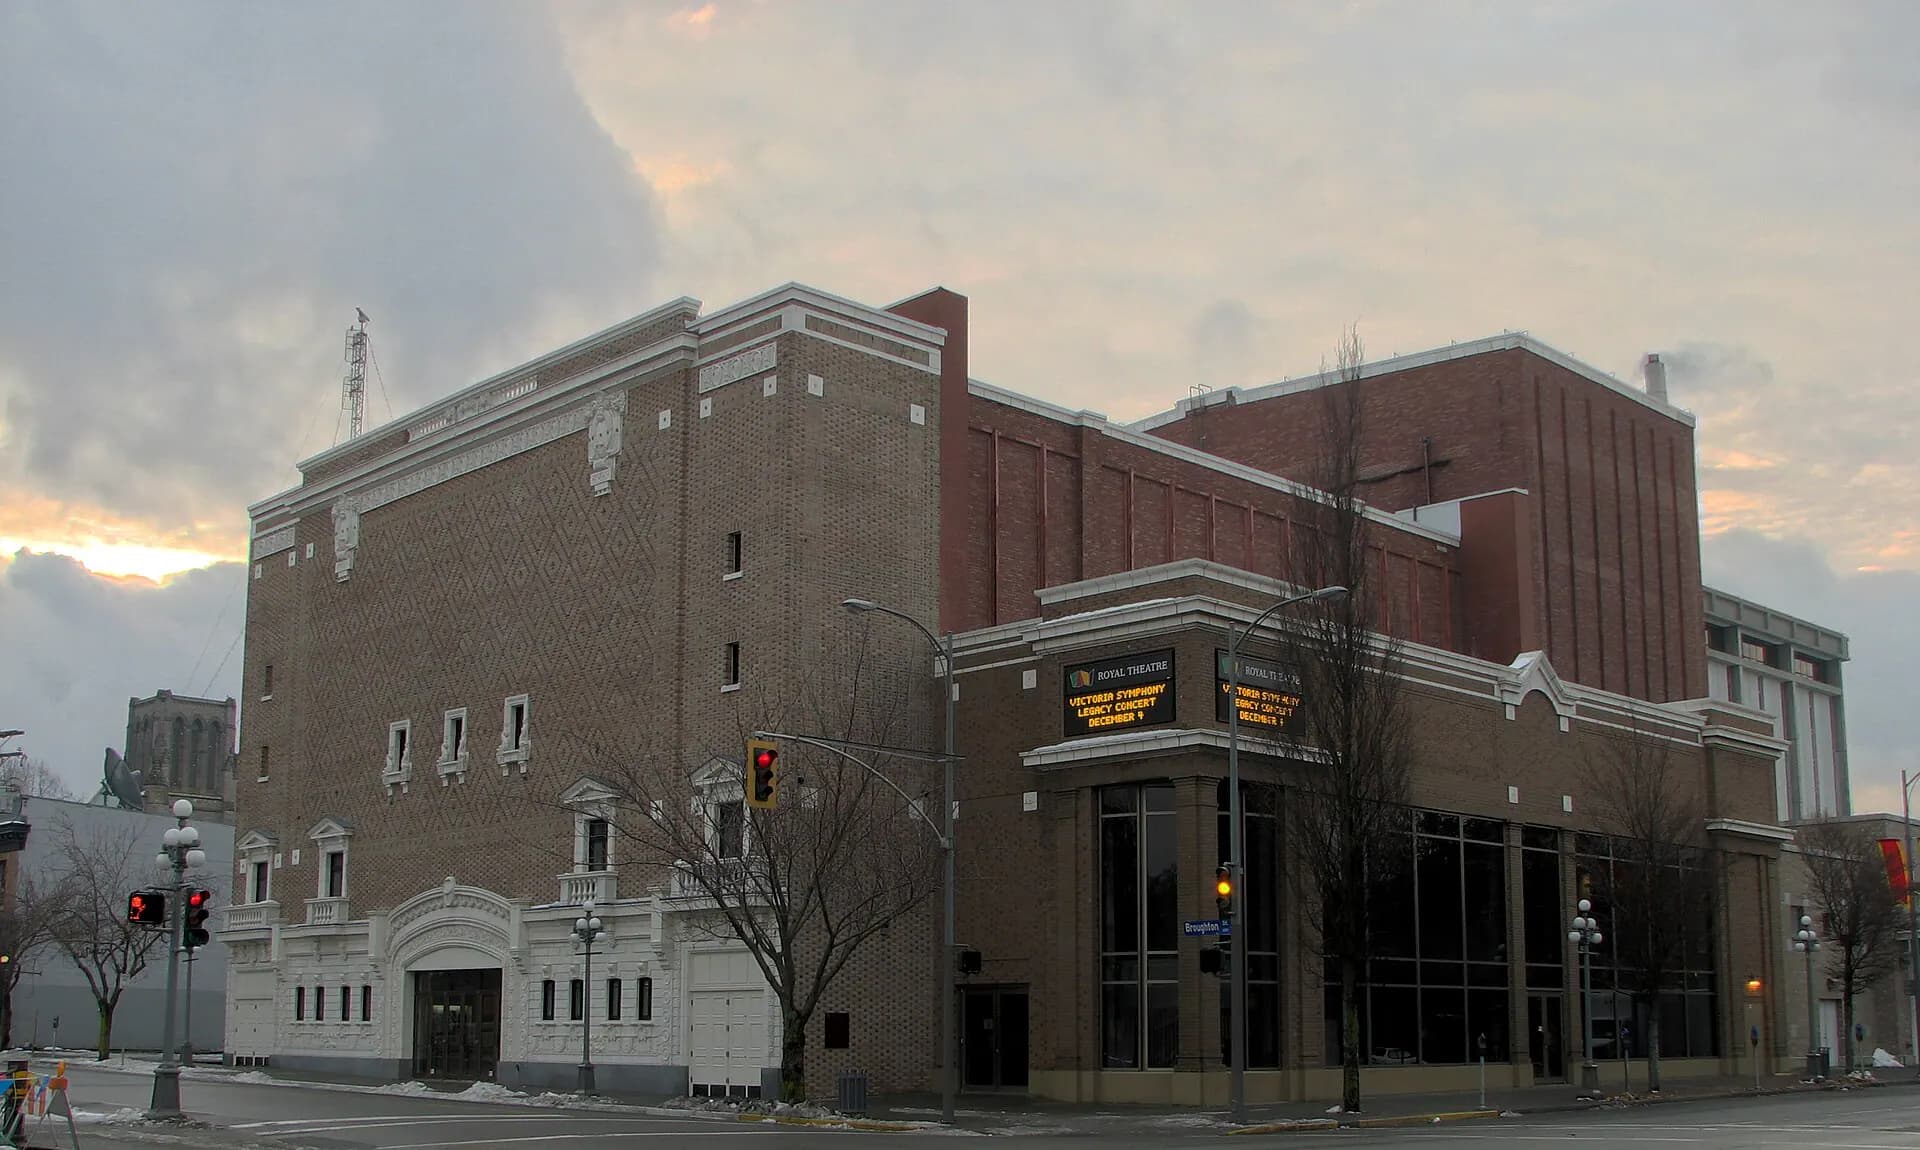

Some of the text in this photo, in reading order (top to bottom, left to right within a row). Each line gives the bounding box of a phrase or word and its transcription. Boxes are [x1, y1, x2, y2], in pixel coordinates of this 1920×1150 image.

[1098, 661, 1168, 680] ROYAL THEATRE
[1245, 666, 1269, 679] ROYAL
[1069, 684, 1166, 706] VICTORIA SYMPHONY
[1222, 683, 1260, 698] VTORIA
[1078, 697, 1157, 717] LEGACY CONCERT
[1235, 698, 1260, 711] EGACY
[1088, 712, 1135, 728] DECEMBER
[1185, 922, 1219, 935] Broughton
